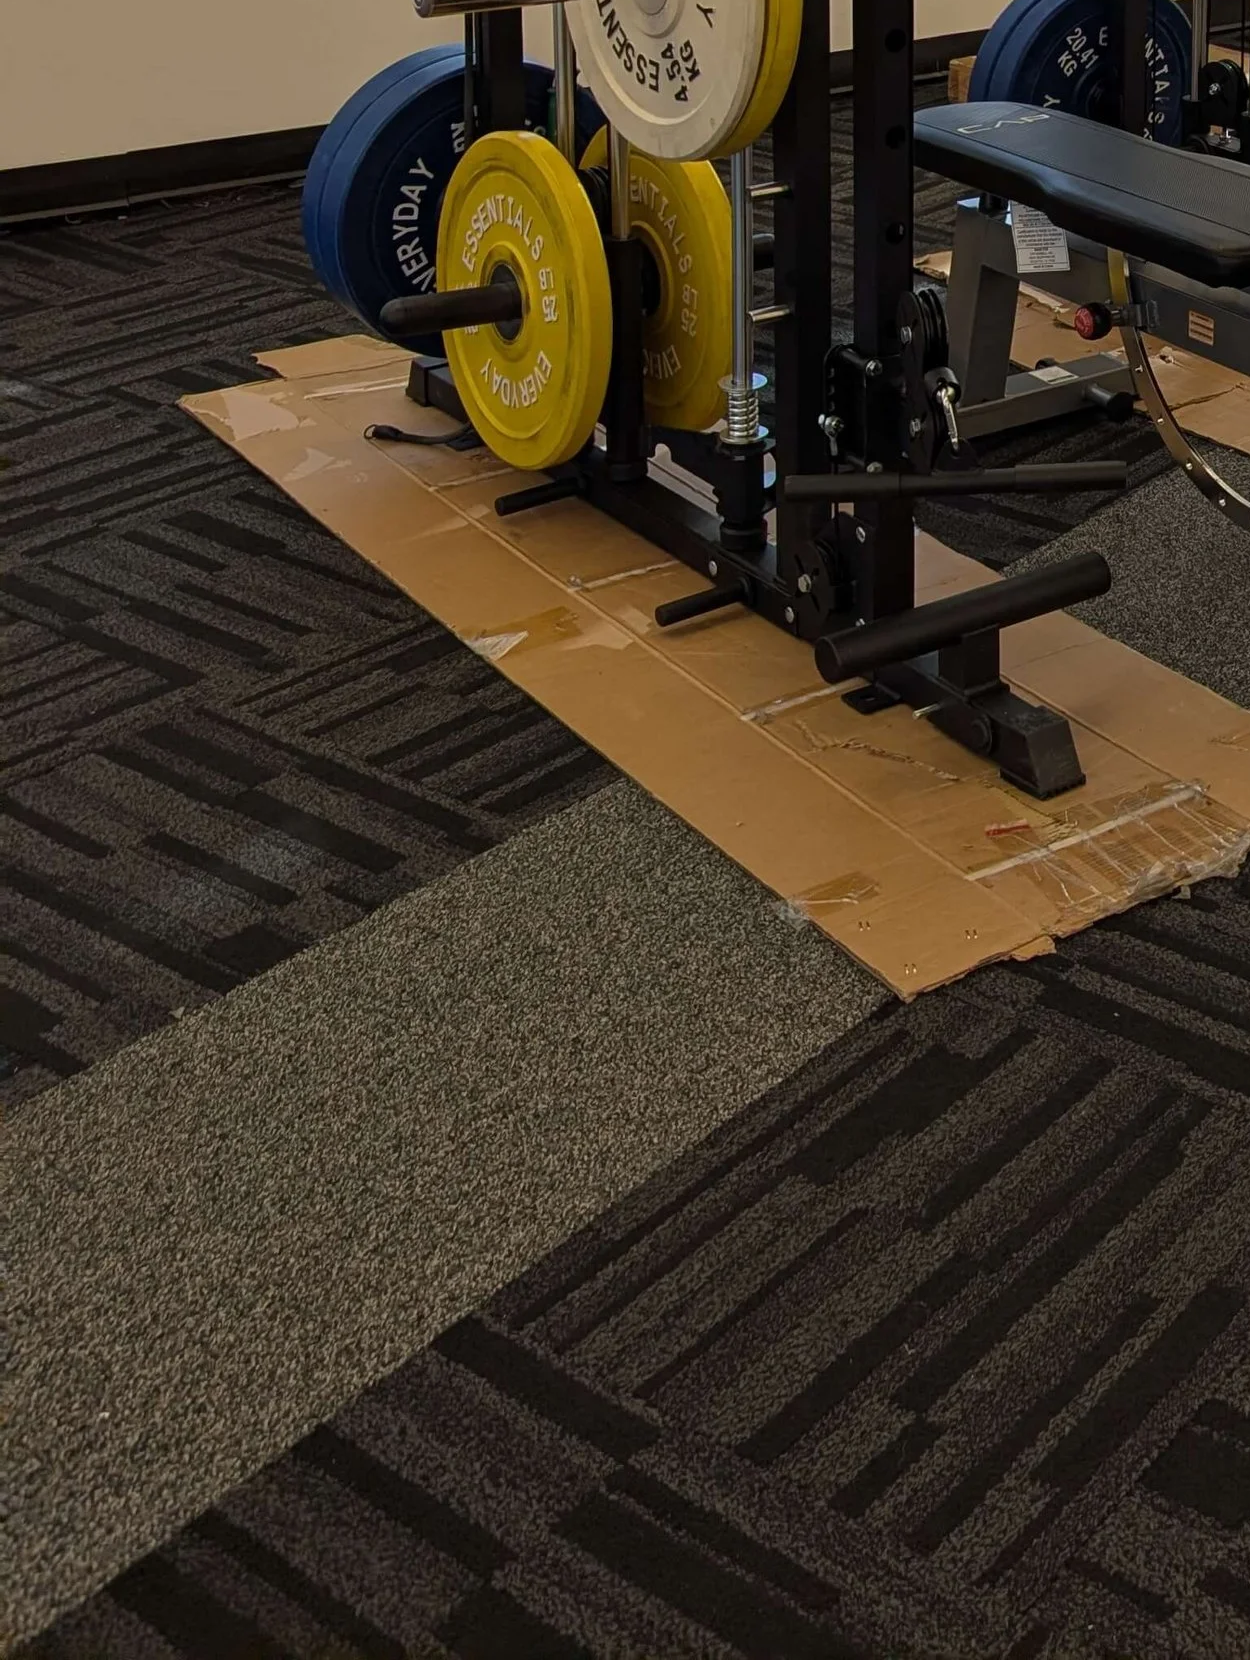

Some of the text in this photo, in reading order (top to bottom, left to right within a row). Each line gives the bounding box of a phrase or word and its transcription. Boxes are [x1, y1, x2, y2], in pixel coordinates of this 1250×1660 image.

[680, 39, 701, 82] KG
[1057, 50, 1077, 77] KG
[1066, 27, 1099, 69] 20.41
[661, 42, 689, 102] 4.54
[957, 114, 1050, 134] CAP
[392, 157, 437, 292] VERYDAY
[461, 193, 544, 272] ESSENTIALS
[630, 175, 692, 273] ENTIALS
[538, 267, 554, 291] LB
[542, 295, 558, 323] 25
[681, 309, 697, 337] 25
[480, 350, 554, 409] EVERYDAY
